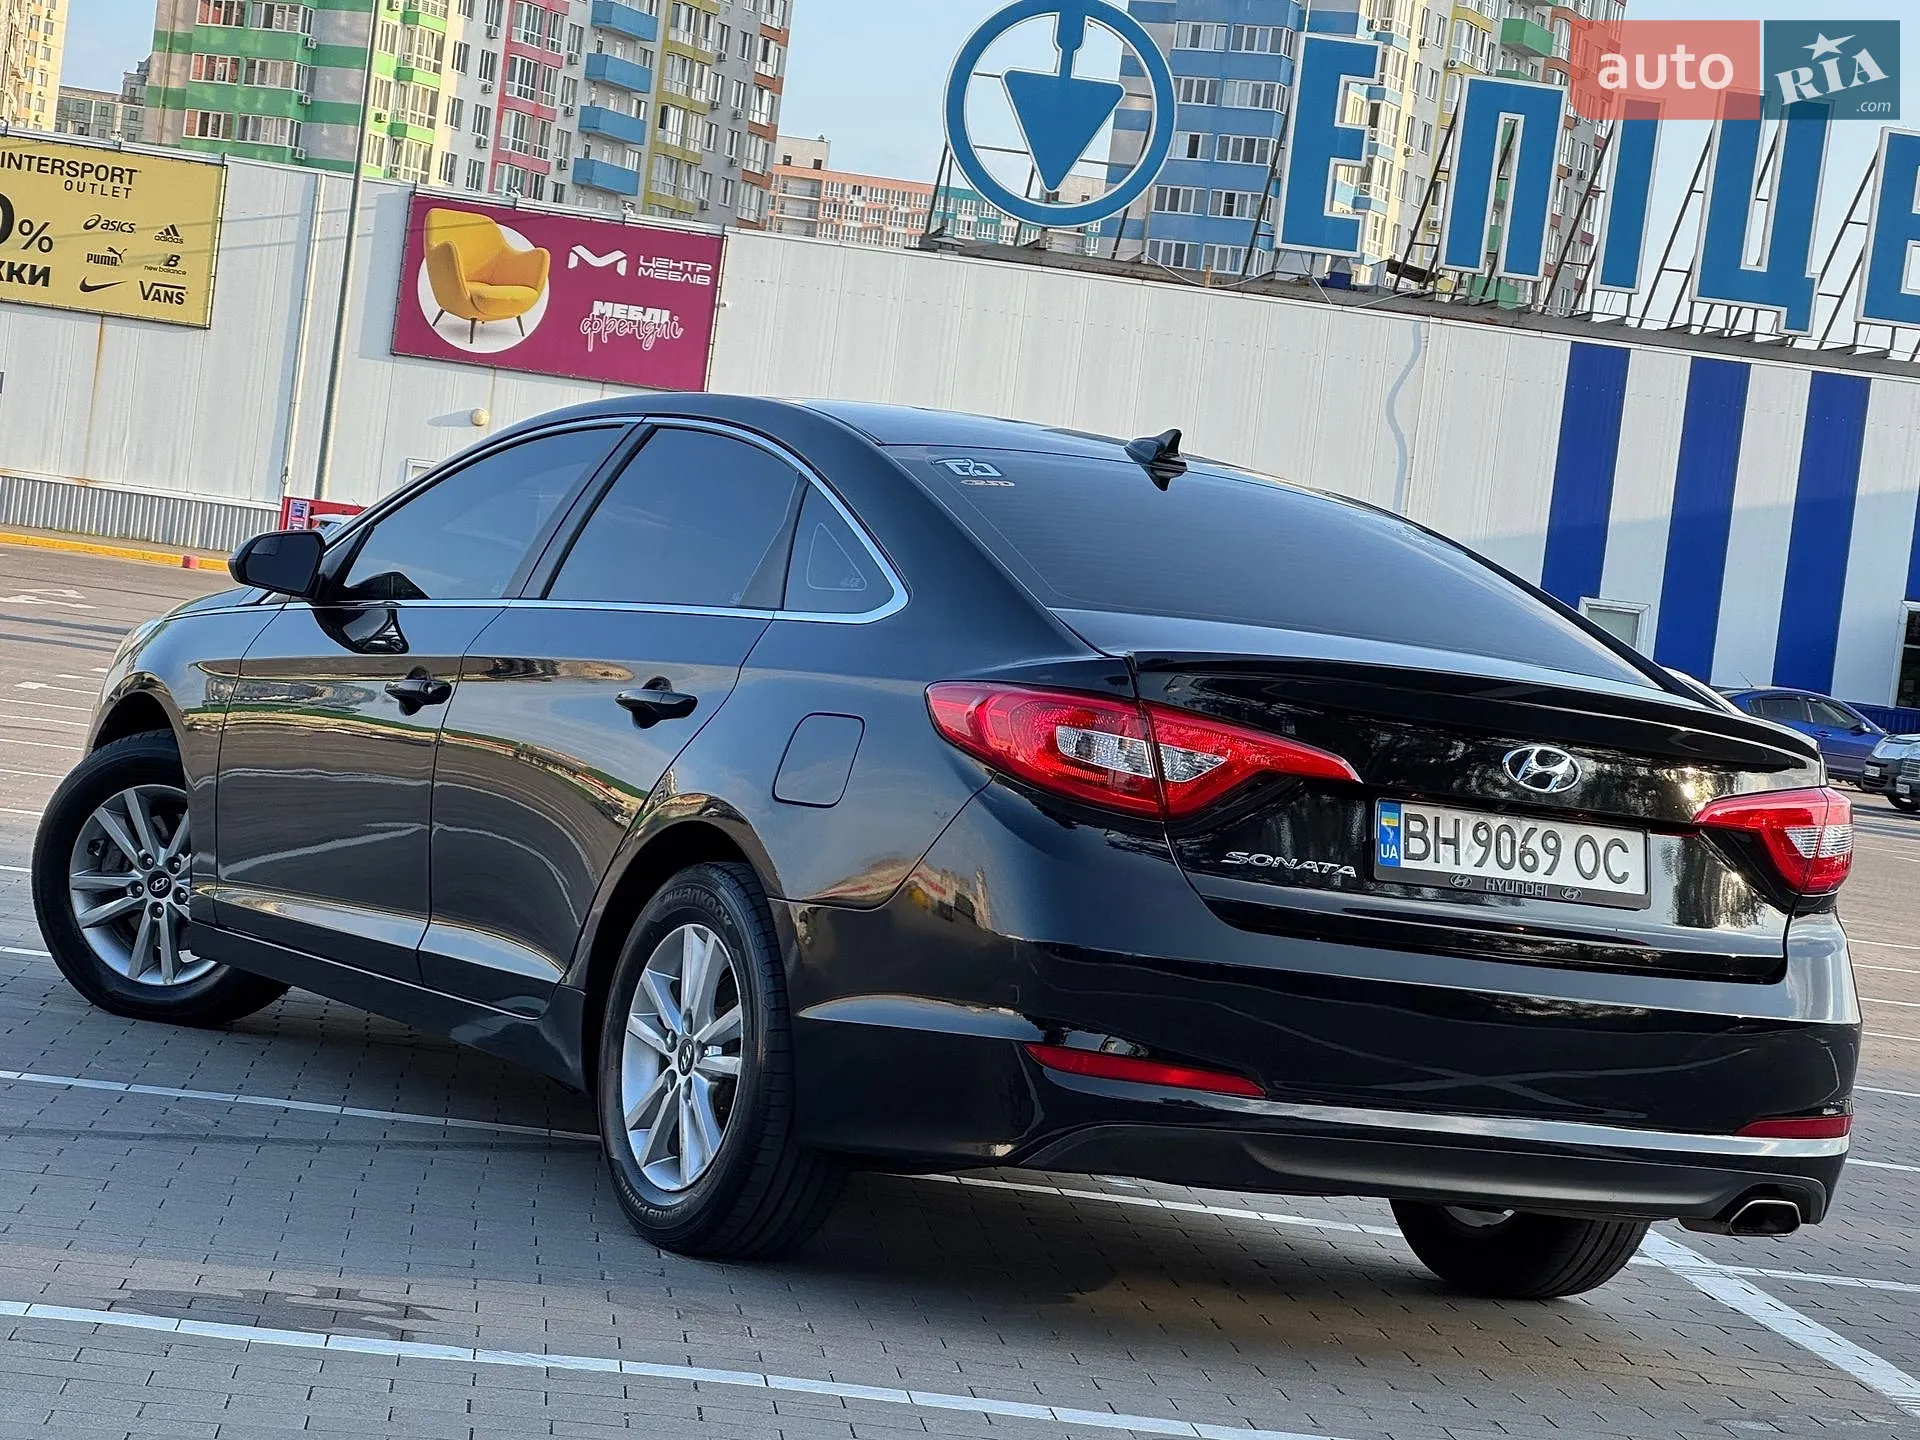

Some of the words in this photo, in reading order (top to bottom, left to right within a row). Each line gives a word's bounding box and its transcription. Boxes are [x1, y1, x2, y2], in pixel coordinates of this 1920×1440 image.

[0, 151, 138, 186] INTERSPORT
[64, 180, 133, 199] OUTLET
[100, 219, 136, 234] asics
[154, 234, 184, 244] adidas
[86, 253, 120, 267] PUMA
[639, 255, 713, 273] ЦЕНТР
[158, 266, 187, 276] balance
[637, 267, 711, 286] МЕБЛІВ
[139, 280, 187, 306] VANS
[592, 300, 671, 324] МЕБЛІ
[1379, 844, 1399, 861] UA
[1403, 812, 1461, 866] BH
[1472, 820, 1563, 876] 9069
[1574, 833, 1630, 885] OC
[1219, 850, 1357, 879] SONATA
[1484, 877, 1549, 897] HYUNDAI
